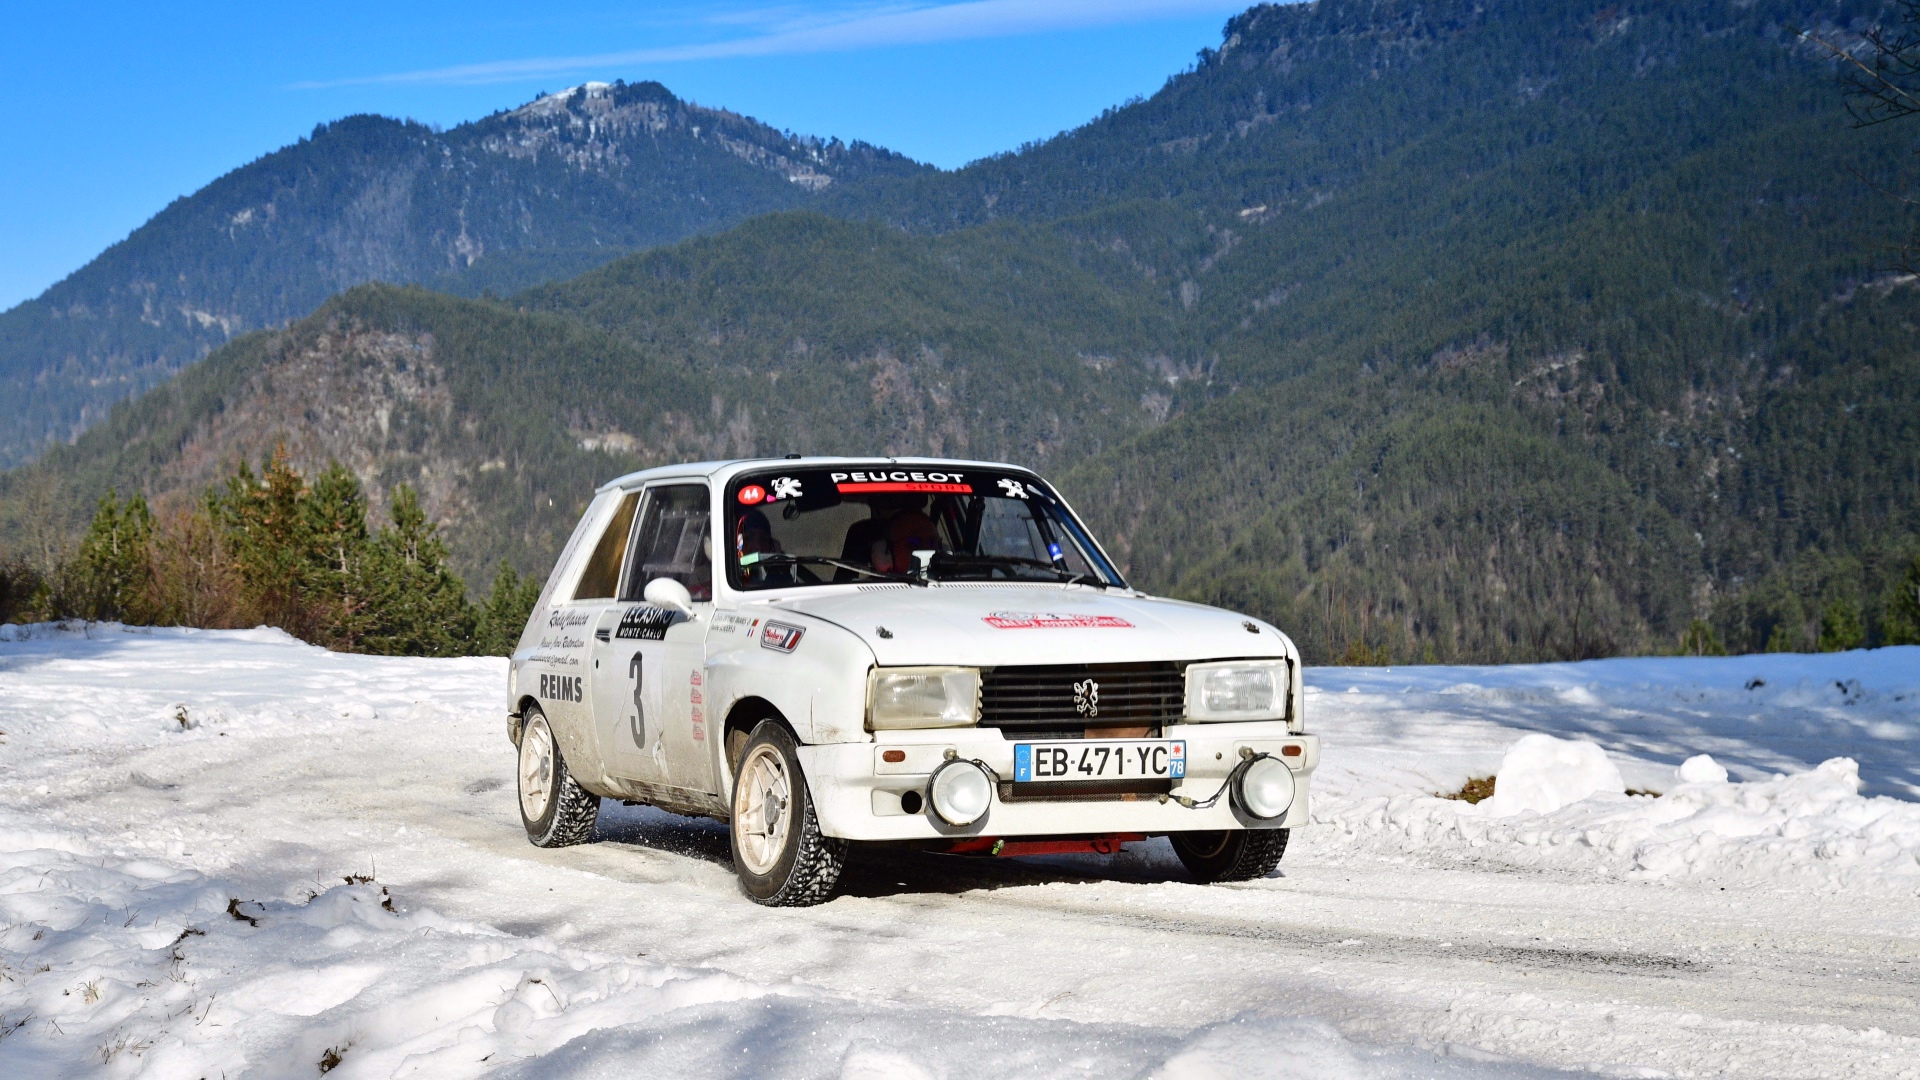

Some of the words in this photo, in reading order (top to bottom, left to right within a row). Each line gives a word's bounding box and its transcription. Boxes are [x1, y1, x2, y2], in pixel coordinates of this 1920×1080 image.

[831, 472, 963, 484] PEUGEOT
[743, 488, 758, 500] 44
[905, 483, 967, 492] SPORT
[634, 606, 674, 625] CASINO
[540, 673, 583, 703] REIMS
[629, 650, 646, 749] 3
[1035, 746, 1168, 776] EB-471-YC
[1171, 761, 1184, 775] 78
[1020, 767, 1026, 777] F
